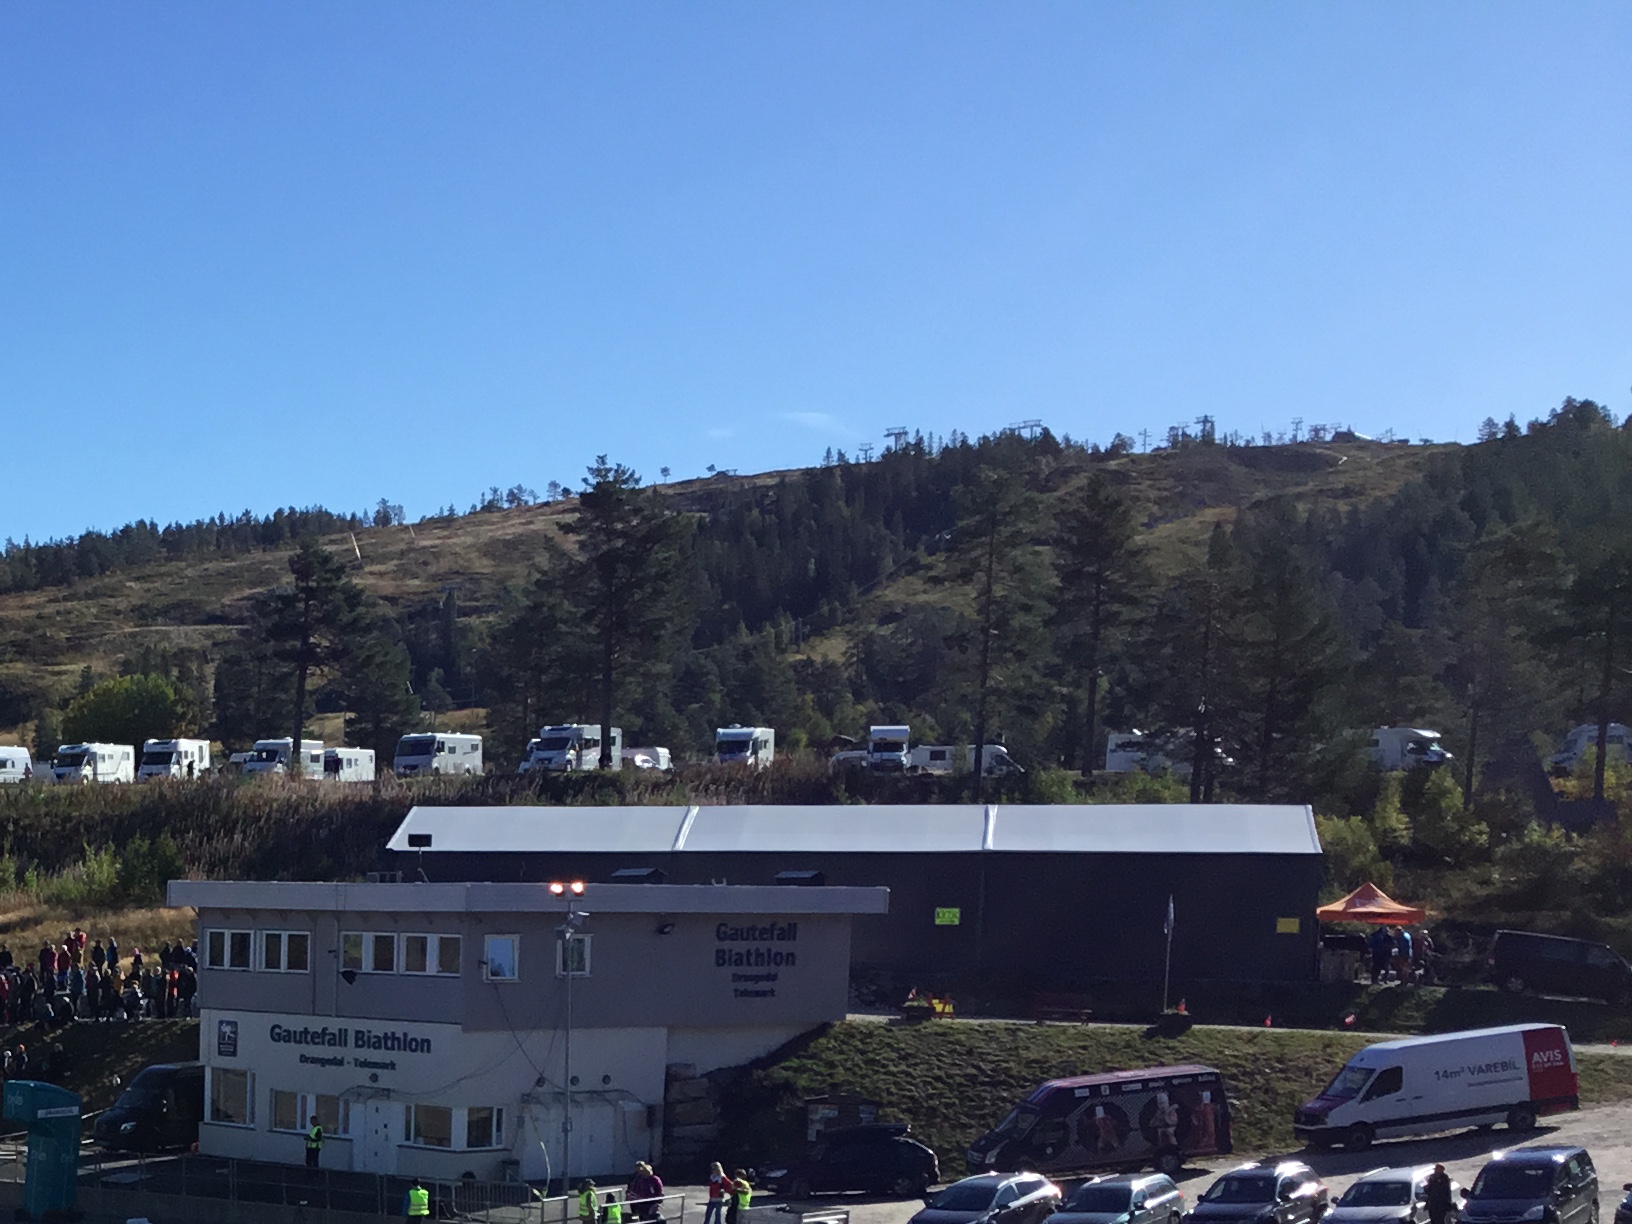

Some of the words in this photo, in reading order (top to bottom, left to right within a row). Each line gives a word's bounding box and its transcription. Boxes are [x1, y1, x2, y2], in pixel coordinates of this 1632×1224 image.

[715, 921, 798, 942] Gautefall
[714, 947, 797, 967] Biathlon
[269, 1023, 349, 1048] Gautefall
[353, 1029, 432, 1054] Biathlon
[1531, 1049, 1562, 1064] AVIS
